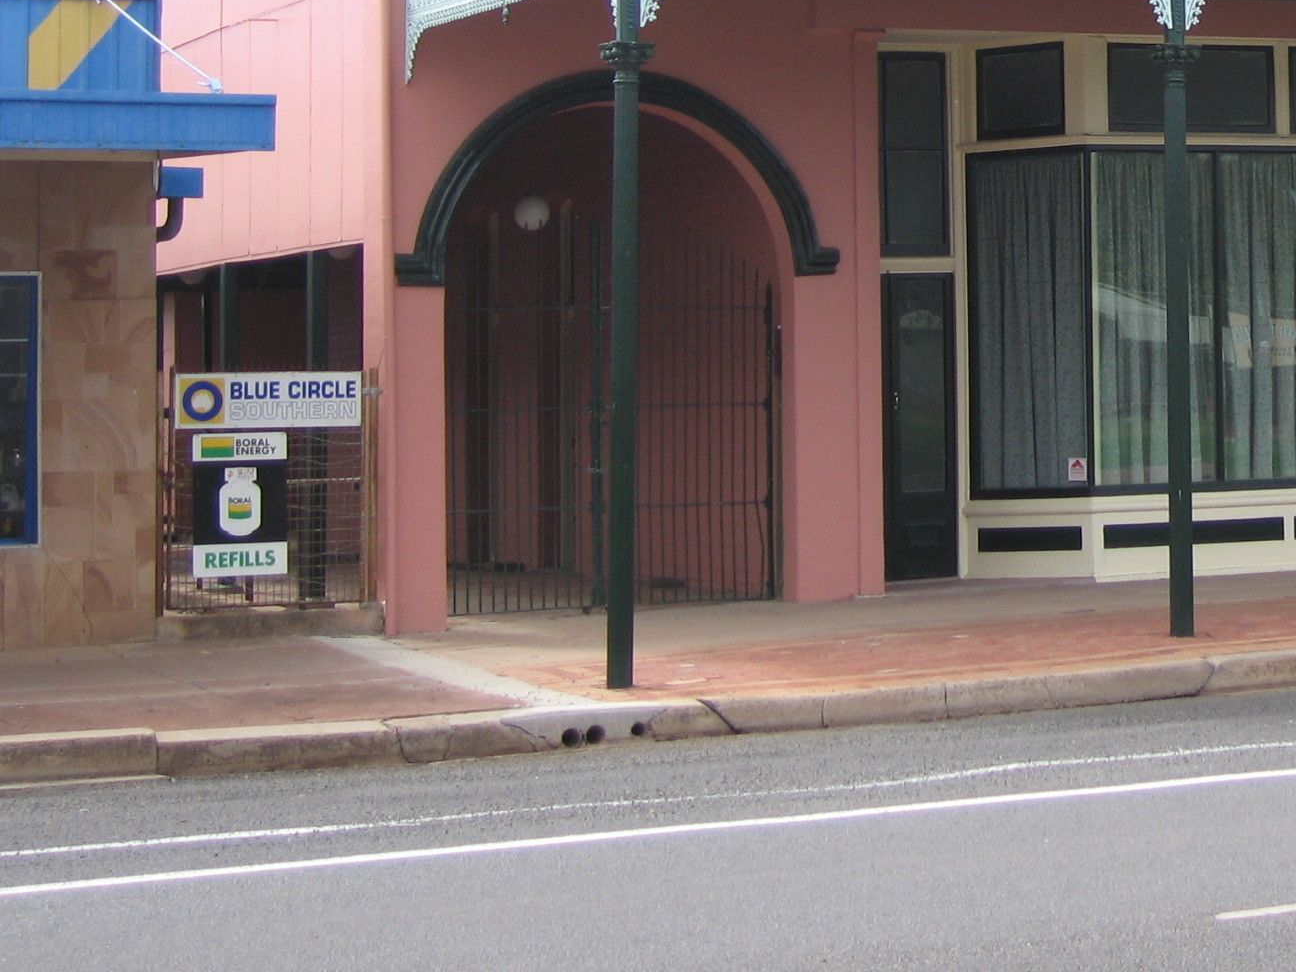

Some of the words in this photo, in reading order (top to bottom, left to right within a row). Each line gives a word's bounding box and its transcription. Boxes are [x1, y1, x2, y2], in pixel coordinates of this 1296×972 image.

[230, 381, 280, 400] BLUE
[288, 380, 357, 399] CIRCLE
[230, 401, 357, 421] SOUTHERN
[236, 438, 269, 447] BORAL
[236, 446, 276, 455] ENERGY
[205, 549, 276, 568] REFILLS
